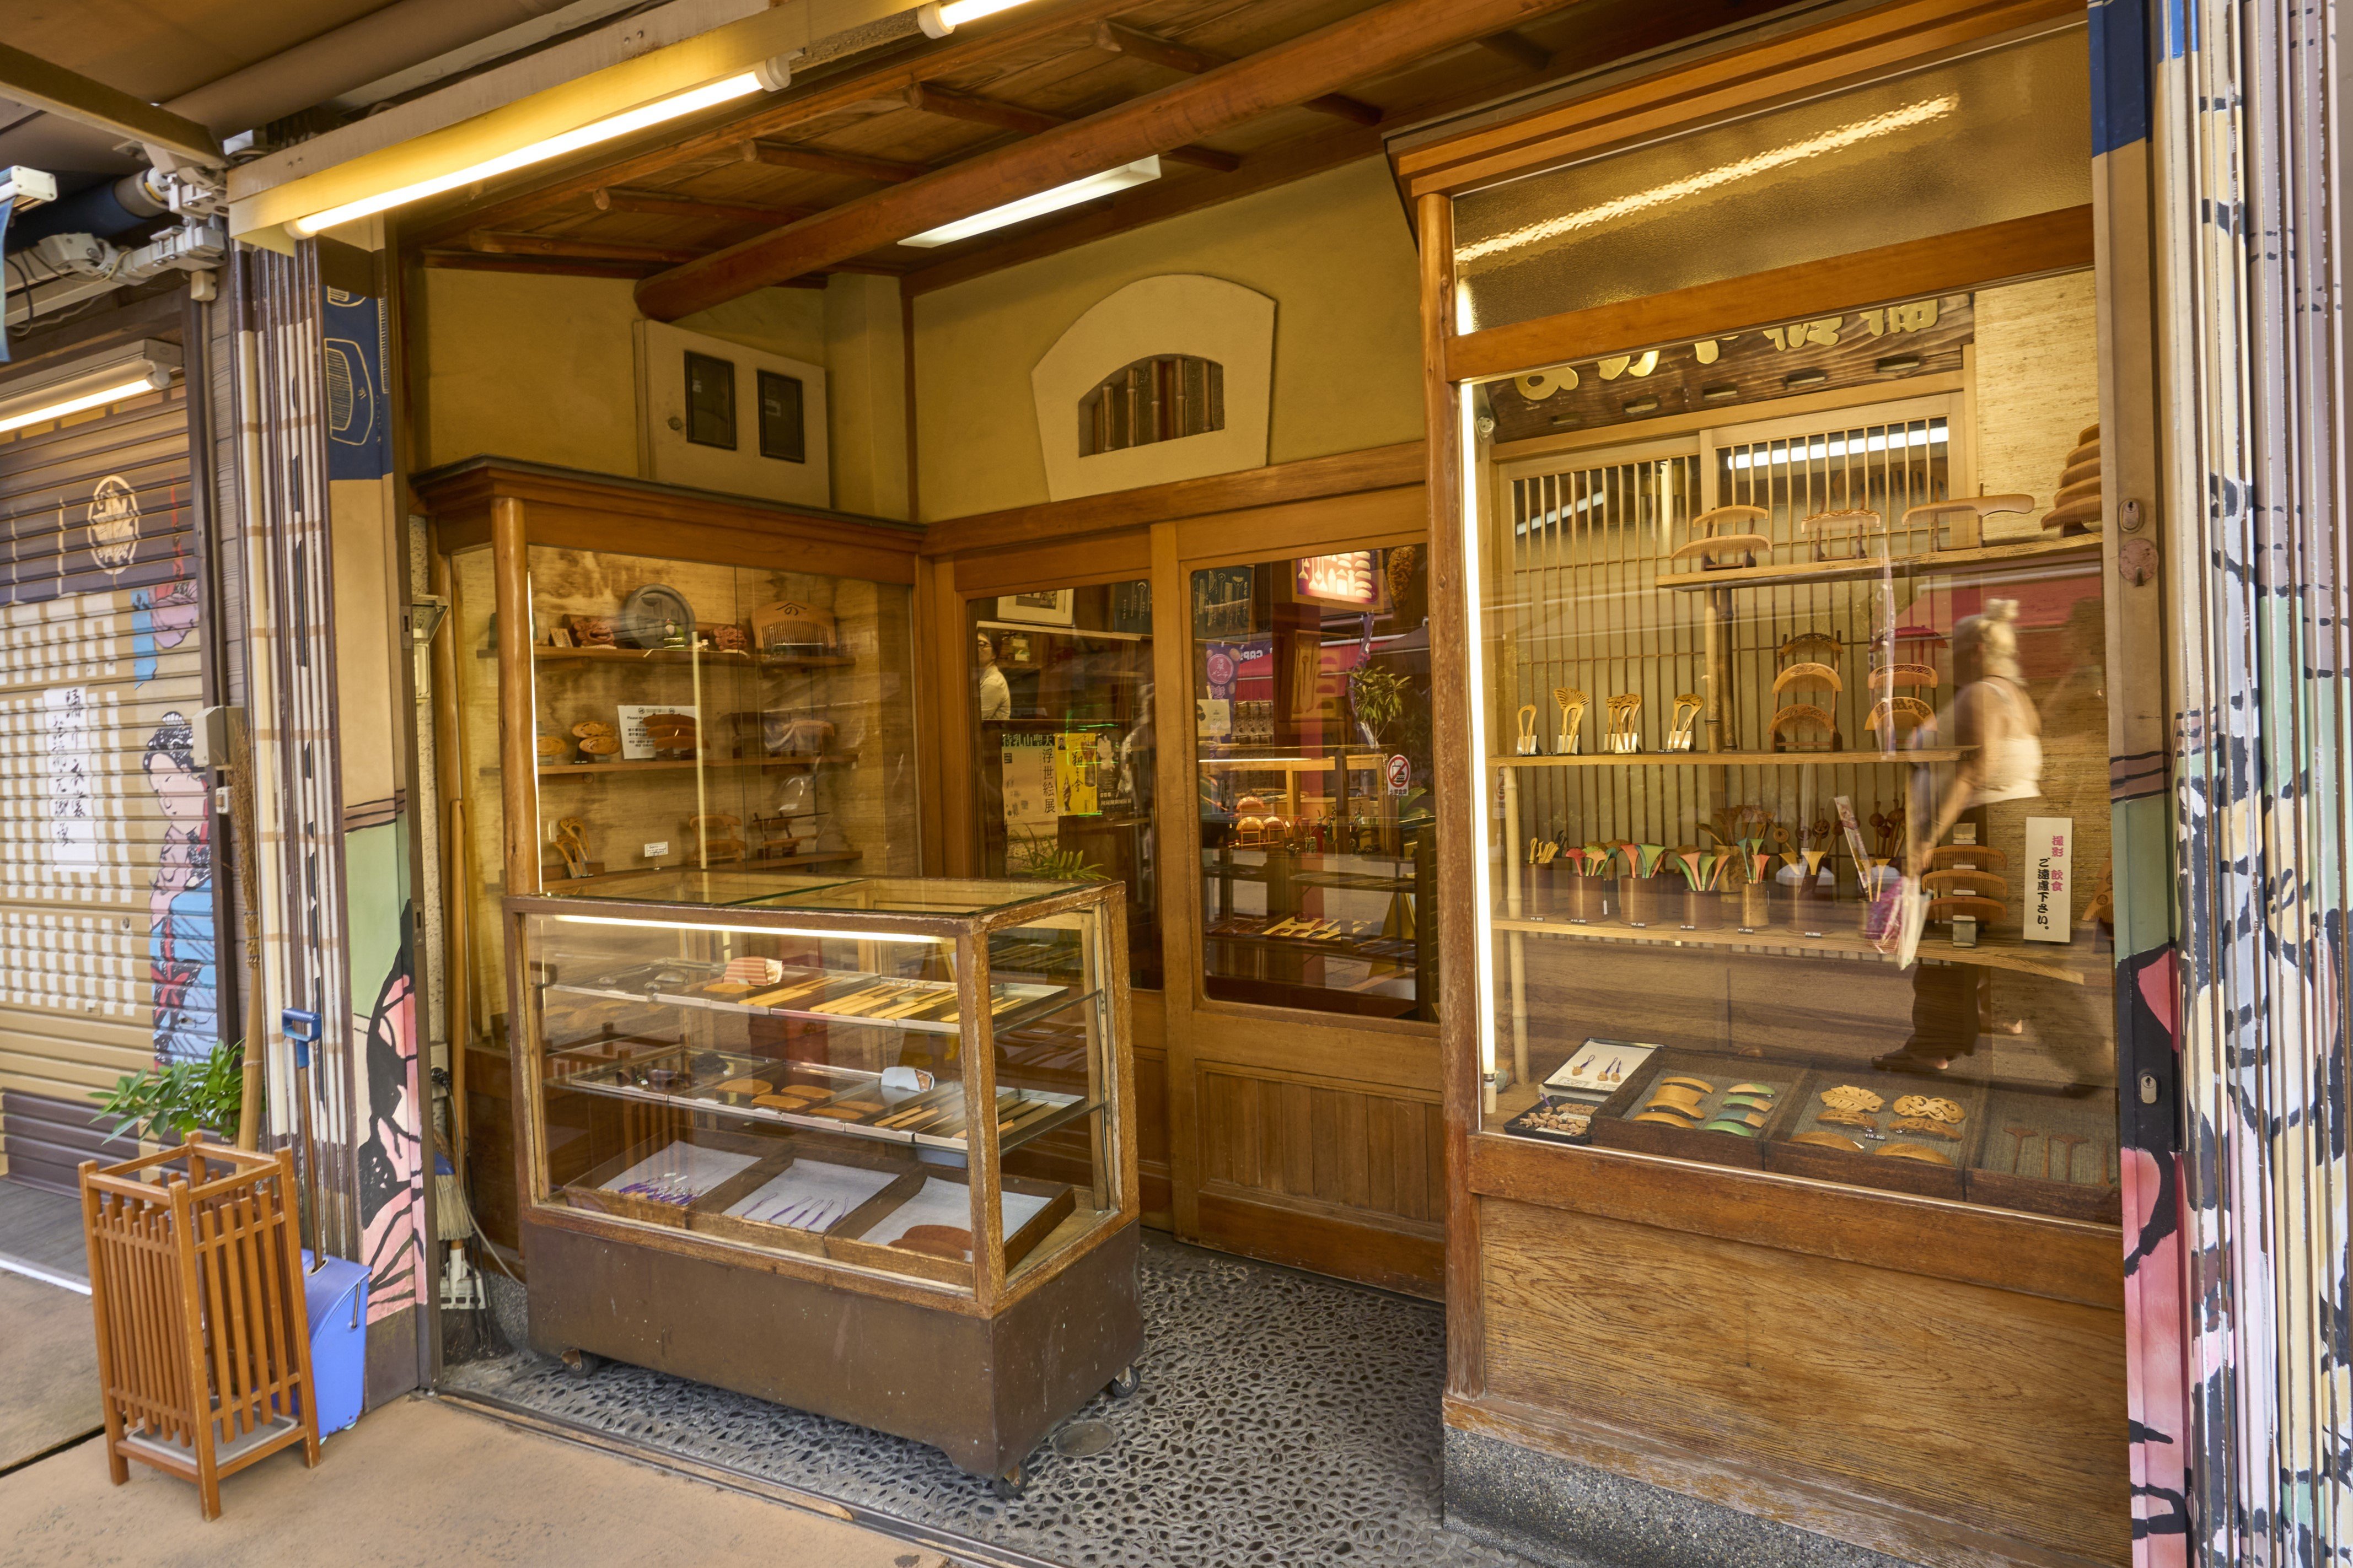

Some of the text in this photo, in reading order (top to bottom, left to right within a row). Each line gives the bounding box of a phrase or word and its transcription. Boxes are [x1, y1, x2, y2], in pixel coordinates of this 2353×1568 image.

[1002, 734, 1054, 747] 待乳山聖天
[1042, 748, 1056, 813] 浮世絵展
[2037, 858, 2050, 930] ご遠慮下さい。
[2051, 836, 2064, 892] 撮影 飲食
